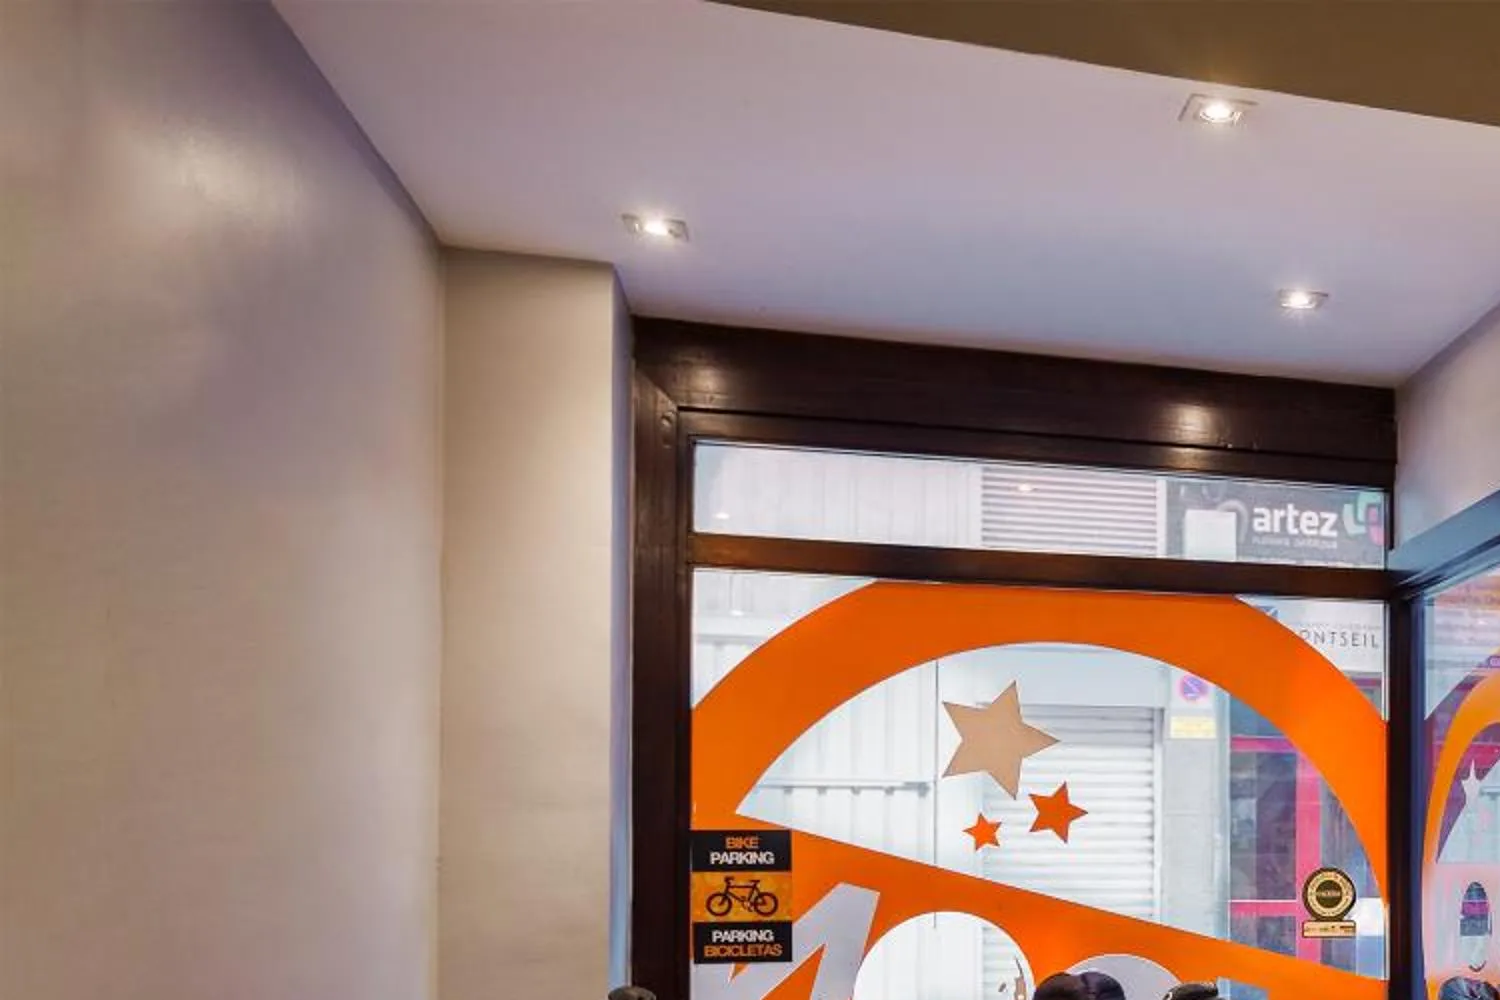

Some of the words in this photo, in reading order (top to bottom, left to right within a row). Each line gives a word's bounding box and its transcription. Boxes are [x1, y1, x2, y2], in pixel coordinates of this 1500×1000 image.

[1252, 503, 1338, 537] artez
[726, 837, 759, 849] BIKE
[710, 851, 774, 866] PARKING
[711, 929, 774, 942] PARKING
[704, 944, 783, 957] BICICLETAS
